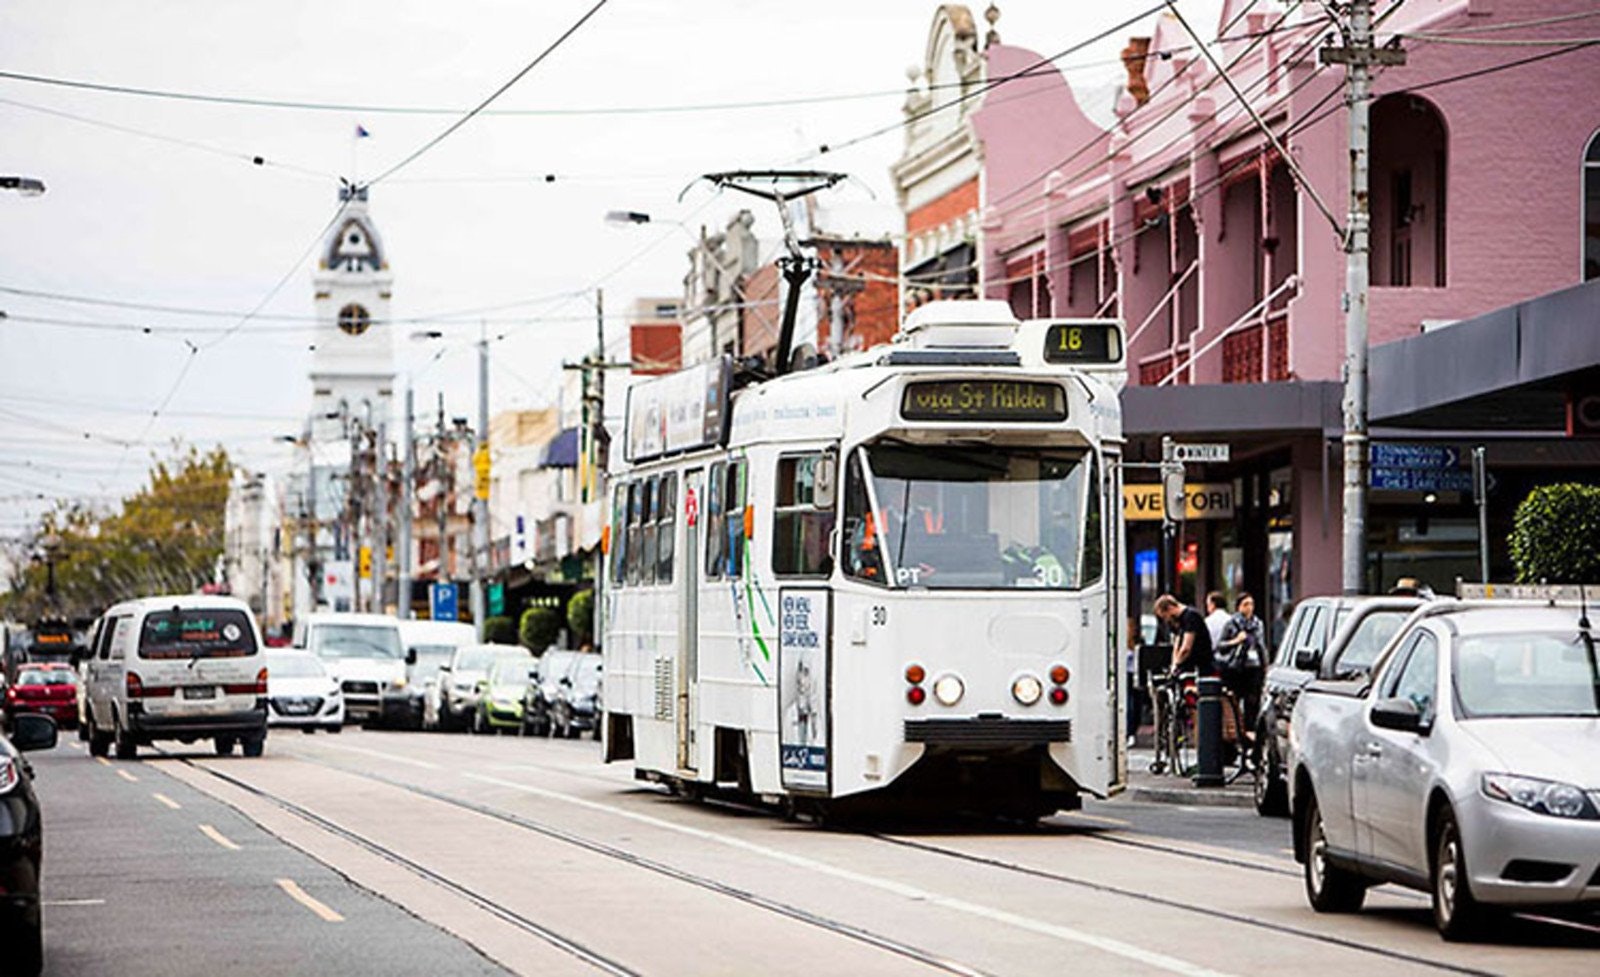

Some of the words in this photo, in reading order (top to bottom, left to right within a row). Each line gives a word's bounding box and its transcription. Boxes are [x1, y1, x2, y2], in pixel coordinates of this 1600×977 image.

[917, 386, 952, 408] via
[959, 383, 985, 408] St
[992, 383, 1046, 408] Kilda
[1032, 565, 1061, 587] 30
[873, 605, 887, 626] 30
